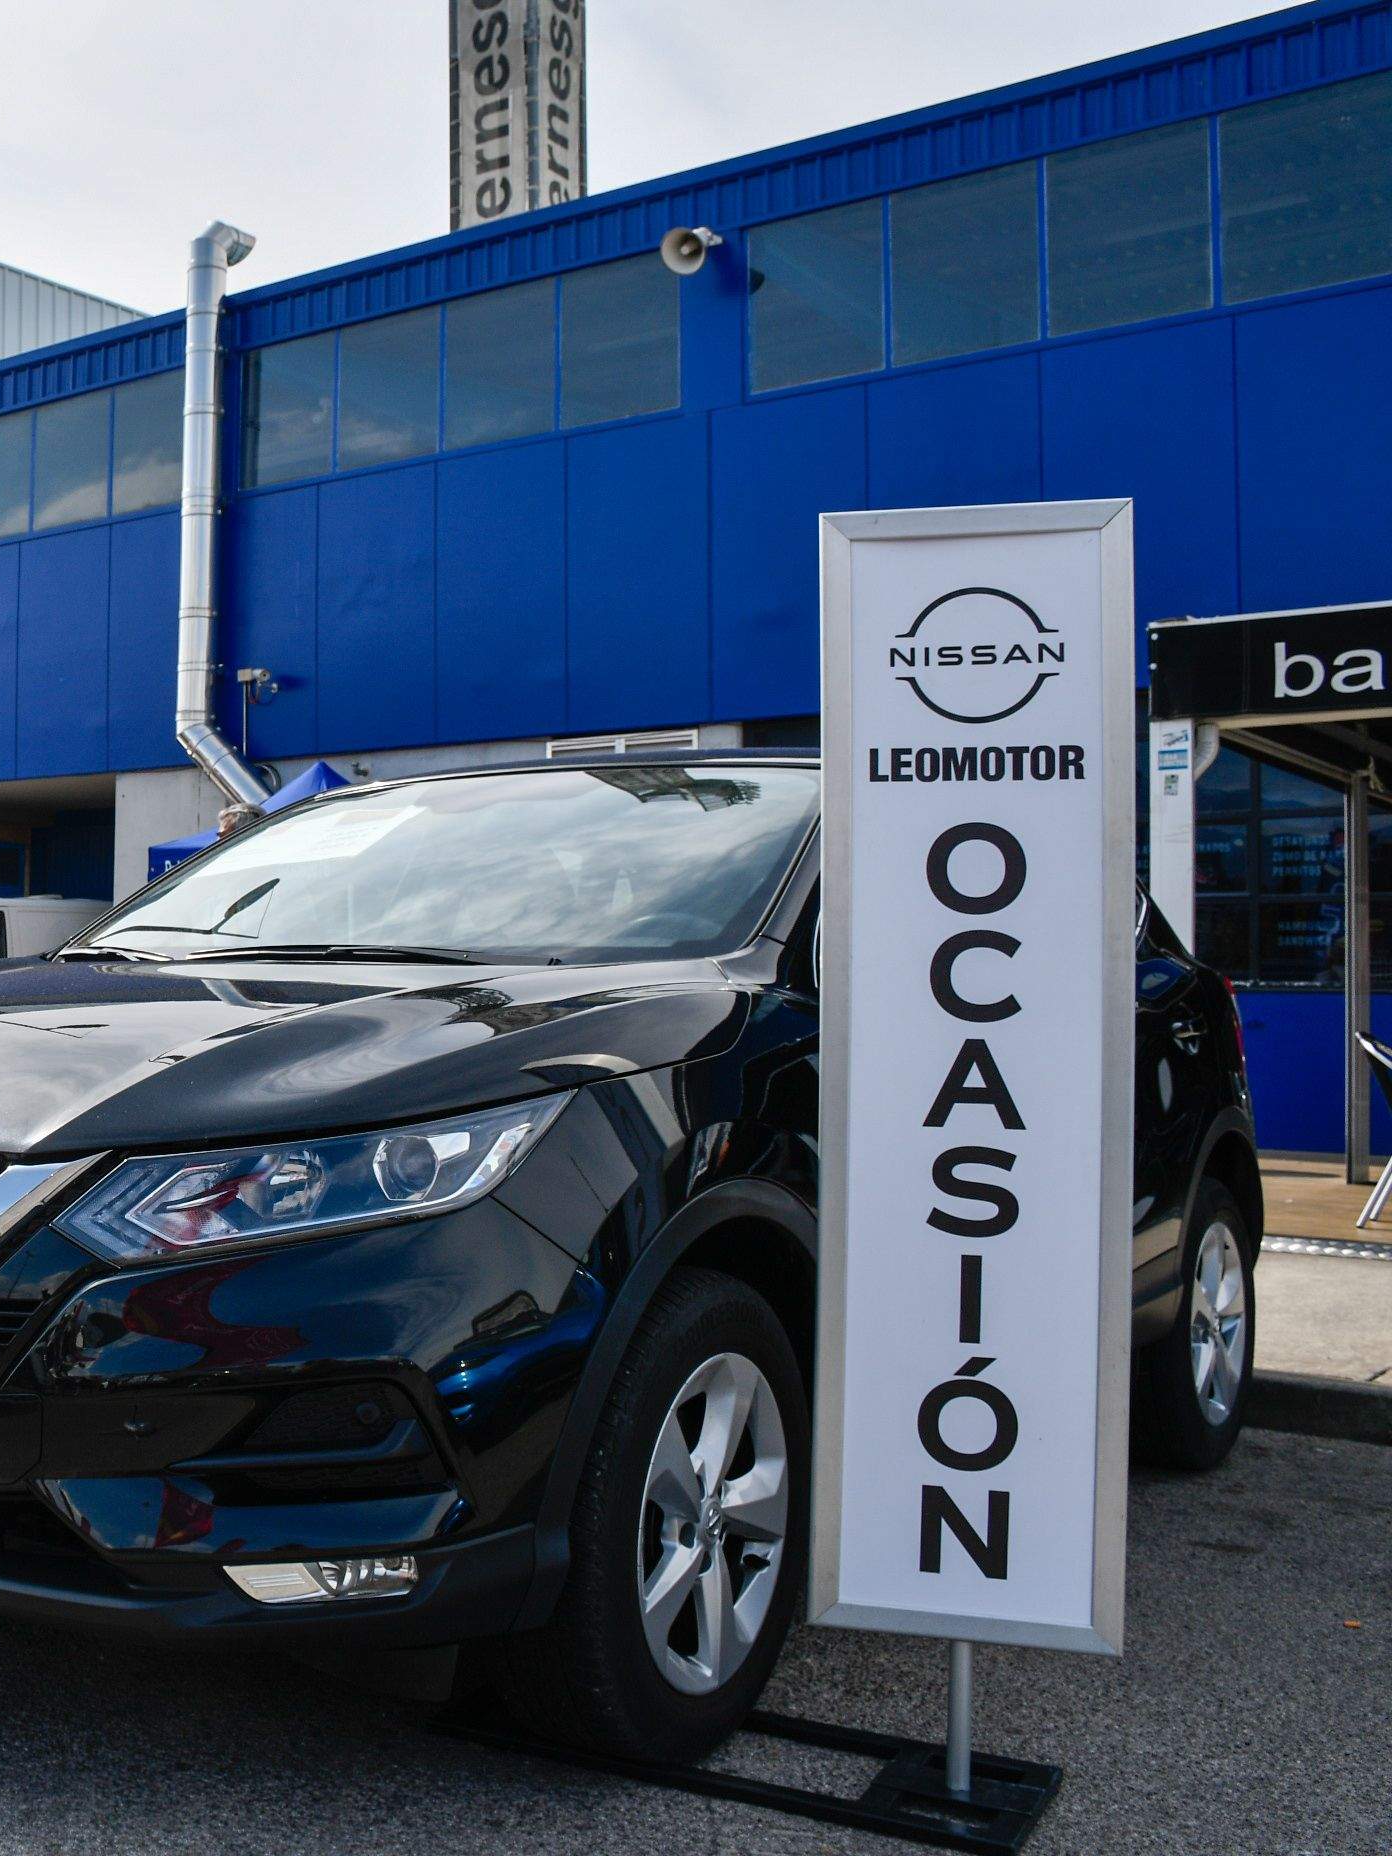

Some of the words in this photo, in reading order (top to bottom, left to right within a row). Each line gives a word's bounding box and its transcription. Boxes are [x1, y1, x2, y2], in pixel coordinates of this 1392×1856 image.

[889, 642, 1065, 668] NISSAN
[1274, 641, 1386, 698] ba
[868, 744, 1086, 783] LEOMOTOR
[917, 822, 1027, 1581] OCASIÓN
